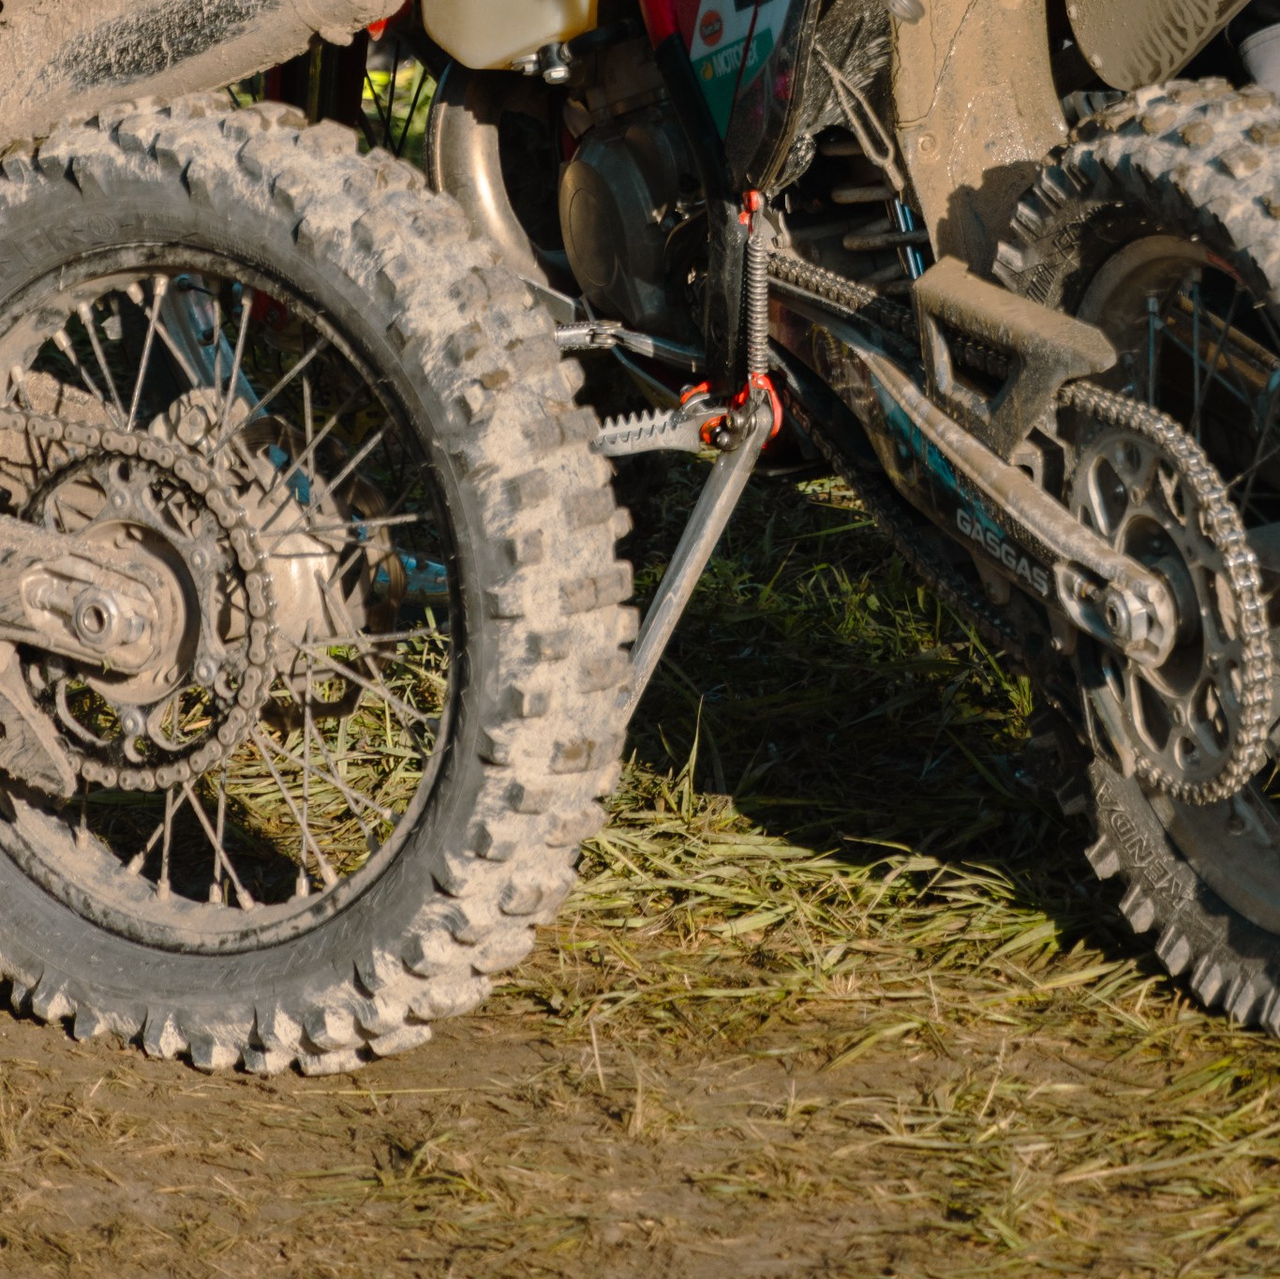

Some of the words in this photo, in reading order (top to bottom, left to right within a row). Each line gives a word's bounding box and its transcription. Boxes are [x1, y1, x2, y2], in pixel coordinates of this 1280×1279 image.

[712, 40, 760, 78] MOTOEX
[956, 507, 1049, 597] GASGAS
[1096, 781, 1194, 910] KENDA
